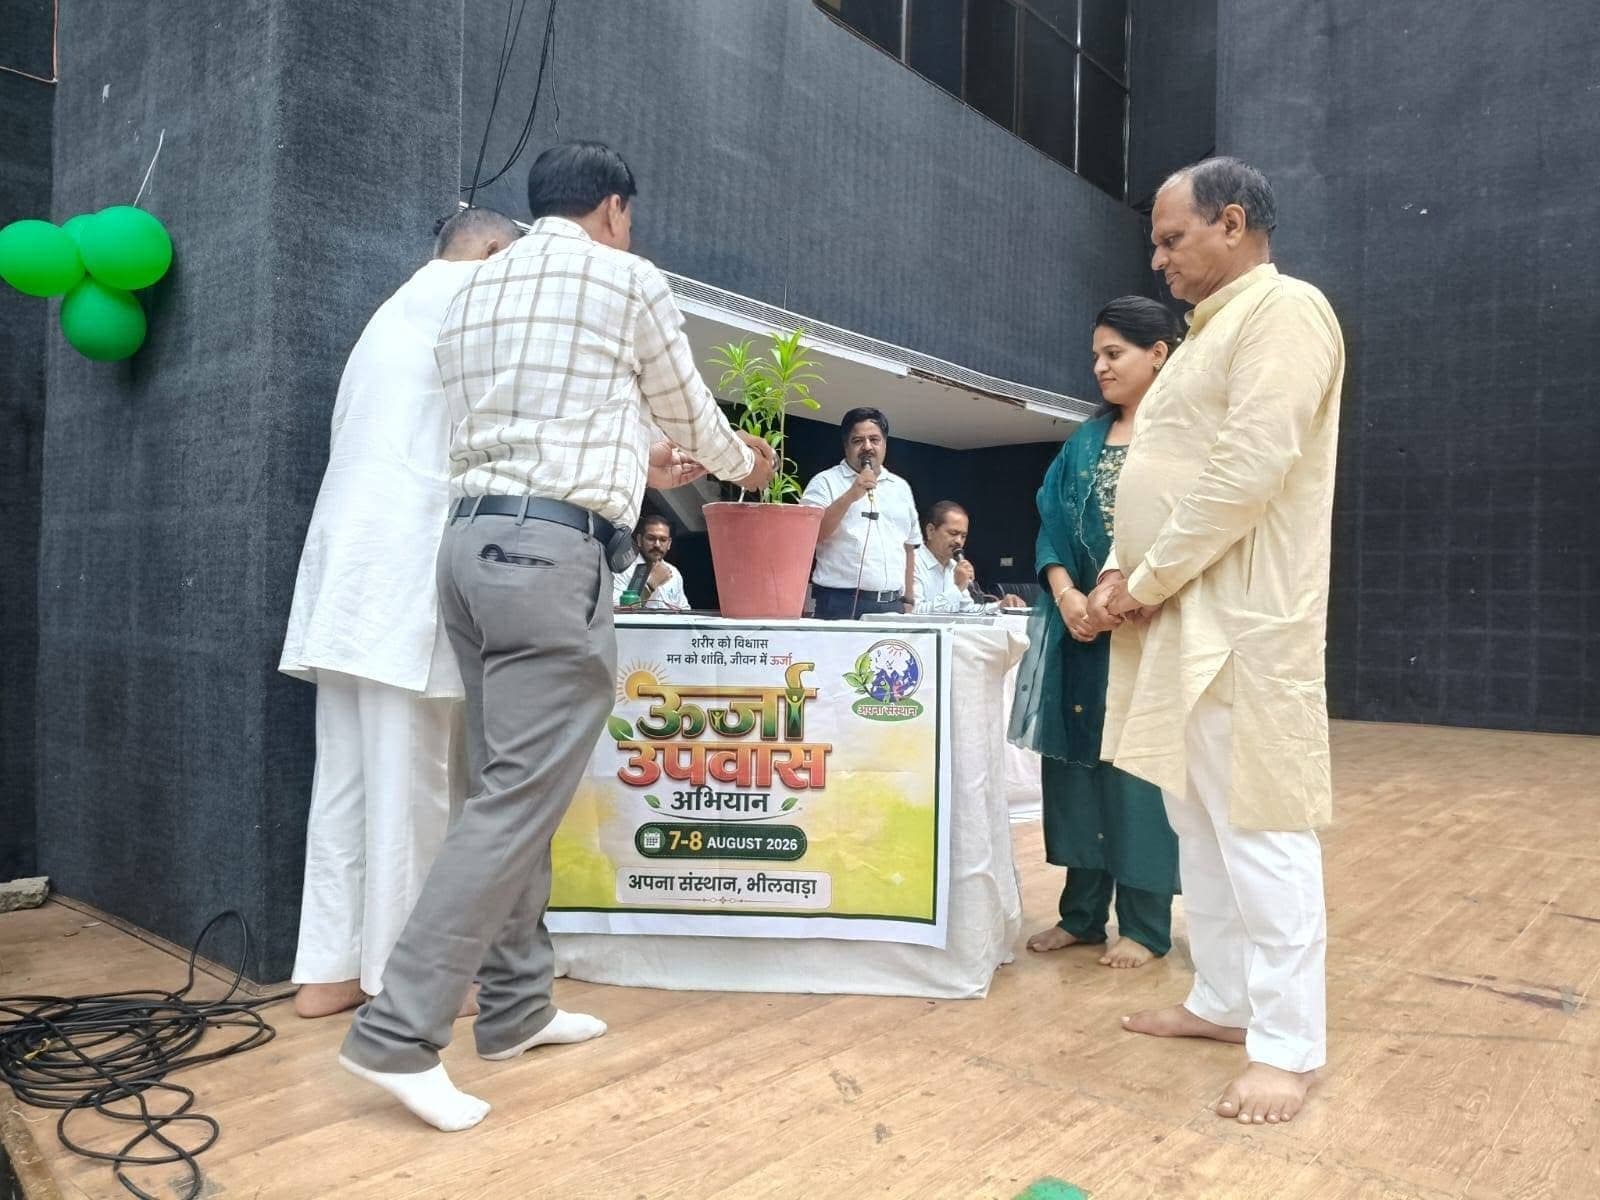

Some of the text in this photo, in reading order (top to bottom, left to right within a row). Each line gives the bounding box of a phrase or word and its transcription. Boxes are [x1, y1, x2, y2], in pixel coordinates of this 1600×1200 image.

[691, 635, 715, 648] शरीर
[718, 636, 731, 648] को
[666, 652, 792, 666] मन को शांति, जीवन में ऊर्जा
[636, 662, 820, 740] ऊर्जा
[857, 703, 918, 717] अपना संस्थान
[617, 740, 832, 790] उपवास
[671, 785, 770, 812] अभियान
[669, 830, 798, 851] 7-8 AUGUST 2026
[628, 872, 817, 899] अपना संस्थान, भीलवाड़ा
